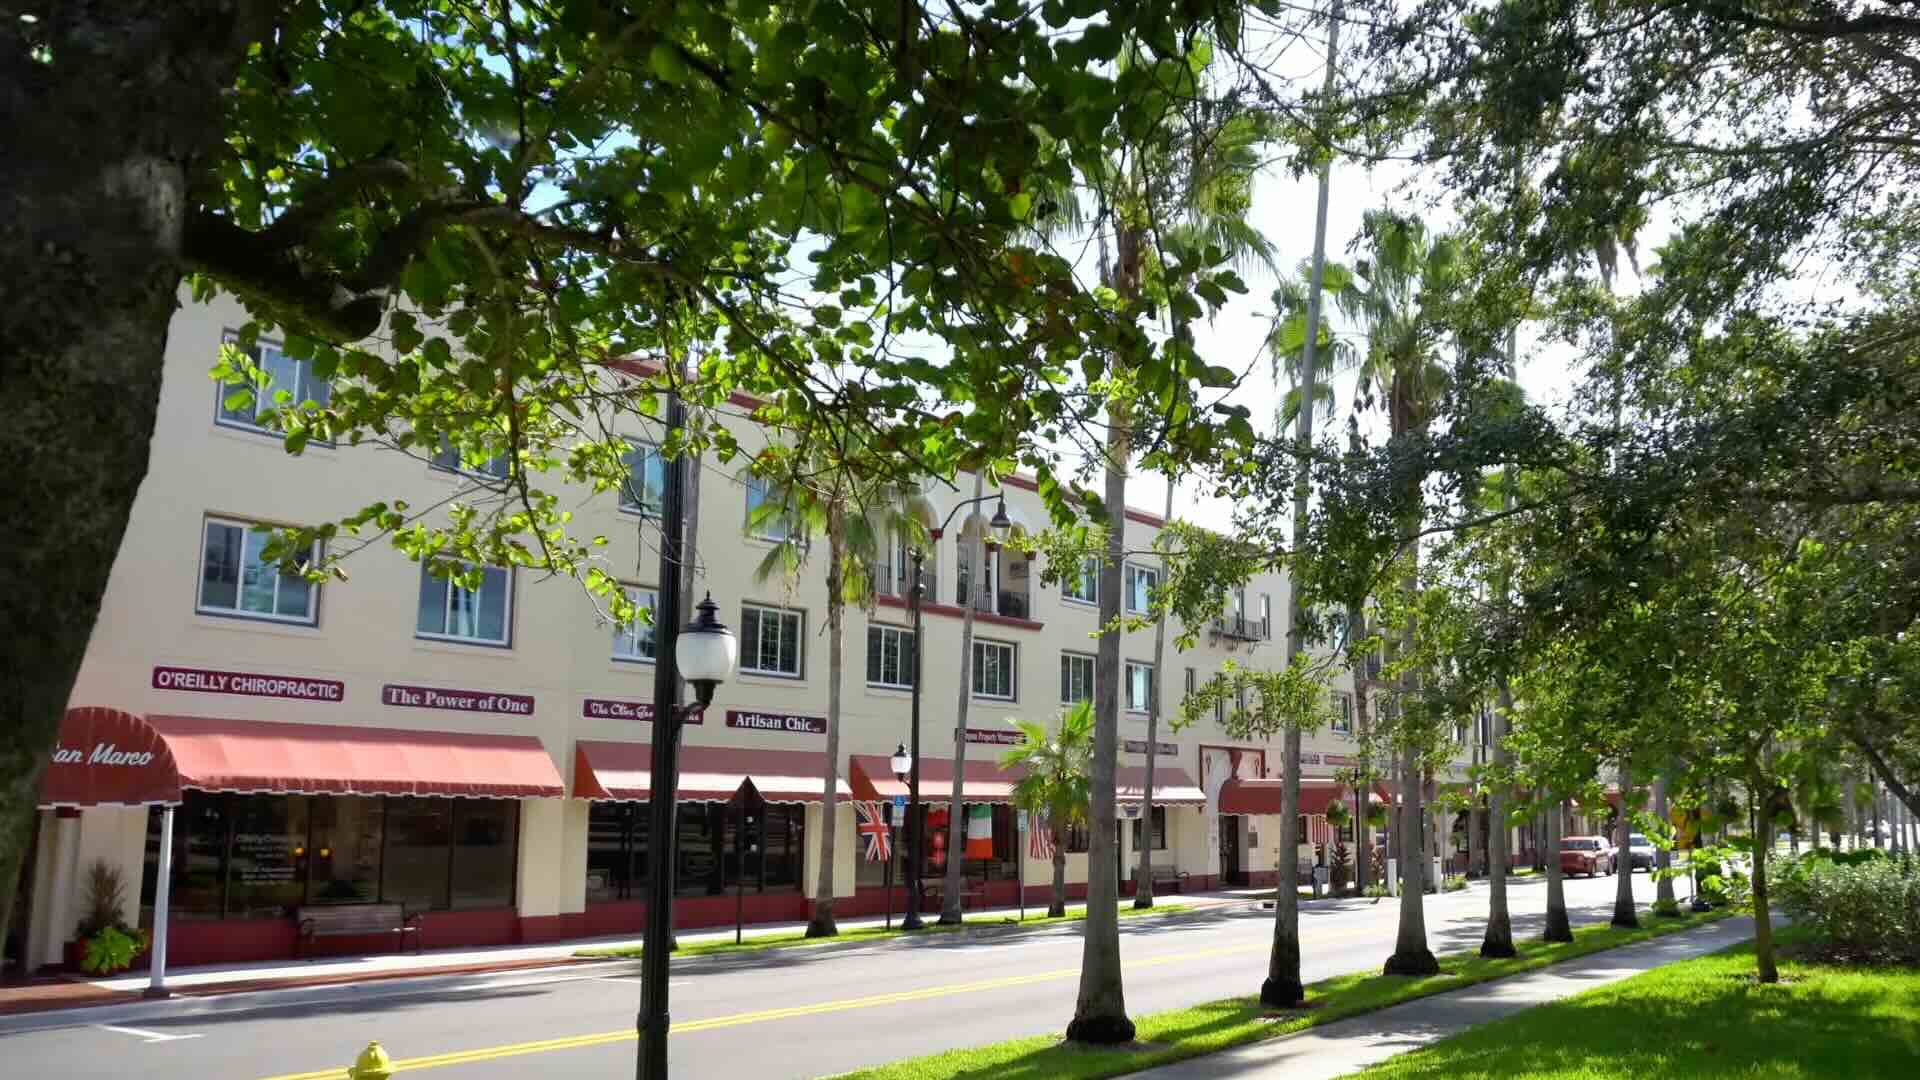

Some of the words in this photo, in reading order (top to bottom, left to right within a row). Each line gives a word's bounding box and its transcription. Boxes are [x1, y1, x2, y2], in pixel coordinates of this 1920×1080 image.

[158, 671, 227, 690] O'REILLY
[231, 677, 339, 699] CHIROPRACTIC
[387, 687, 420, 704] The
[425, 690, 476, 708] Power
[479, 696, 496, 710] of
[497, 697, 529, 712] One
[735, 713, 781, 729] Artisan
[785, 717, 813, 731] Chic
[51, 740, 83, 763] an
[87, 743, 153, 765] Marco
